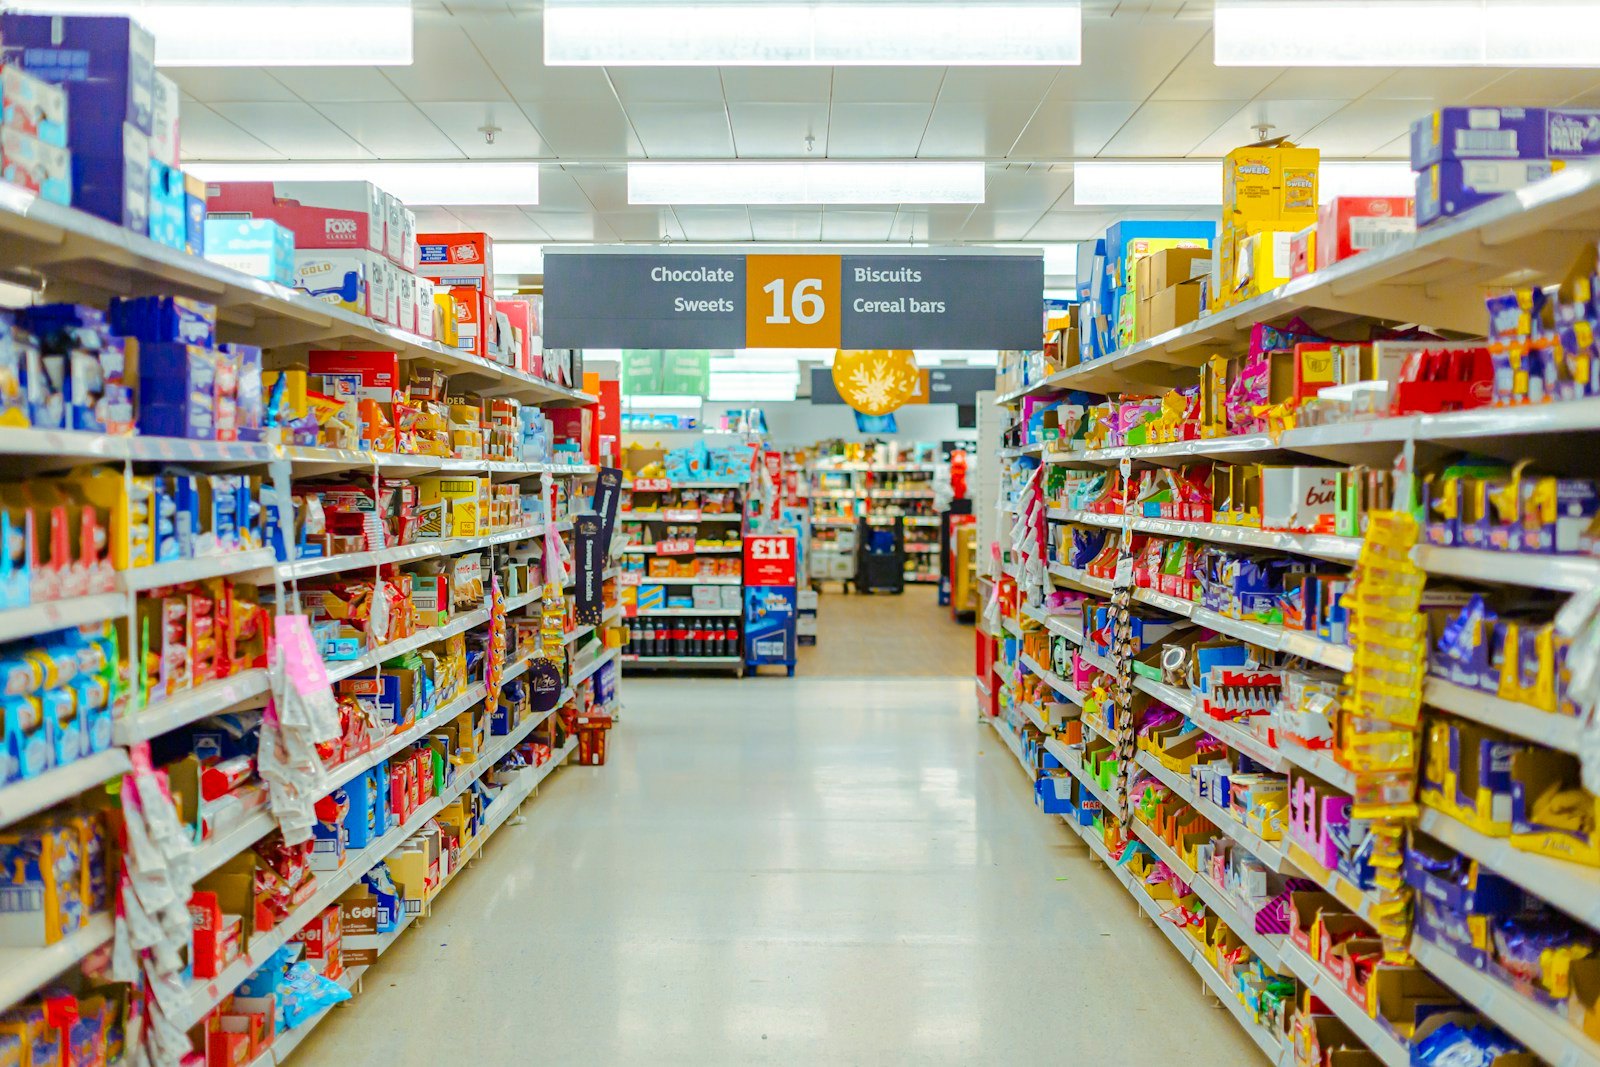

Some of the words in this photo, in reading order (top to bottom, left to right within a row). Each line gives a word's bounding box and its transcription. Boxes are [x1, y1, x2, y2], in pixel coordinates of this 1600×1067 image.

[1238, 165, 1270, 175] SWEETS
[301, 264, 331, 275] GOLD
[651, 267, 734, 282] Chocolate
[854, 267, 922, 282] Biscuits
[674, 297, 734, 312] Sweets
[762, 278, 825, 325] 16
[853, 297, 906, 313] Cereal
[909, 297, 946, 313] bars
[585, 539, 594, 571] Savoury
[751, 539, 790, 559] £11
[586, 571, 594, 602] biscuits
[1082, 800, 1102, 810] HAR
[351, 907, 376, 919] GO!
[296, 929, 321, 941] GO!
